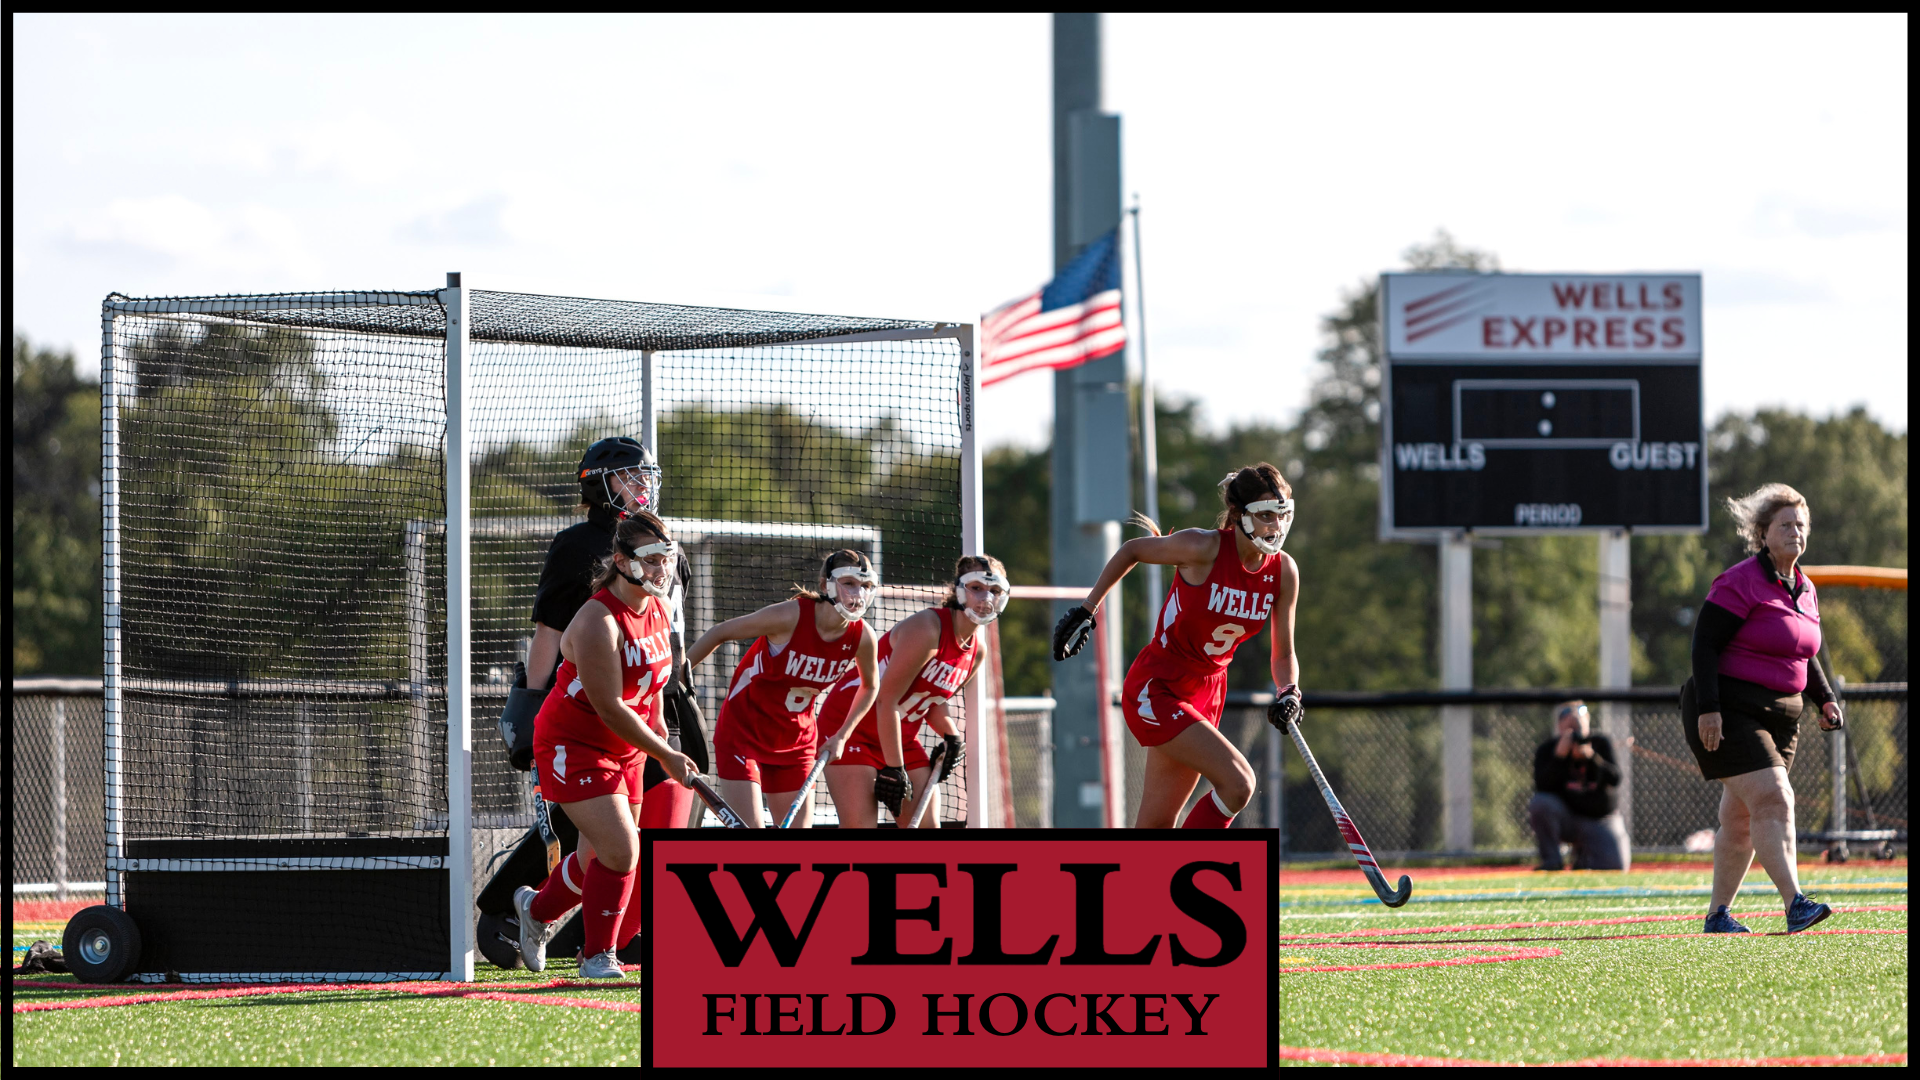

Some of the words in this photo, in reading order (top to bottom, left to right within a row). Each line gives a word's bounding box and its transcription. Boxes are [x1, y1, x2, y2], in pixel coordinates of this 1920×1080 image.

[1552, 283, 1684, 311] WELLS
[1482, 317, 1686, 348] EXPRESS
[964, 404, 972, 432] sports
[1396, 442, 1486, 470] WELLS
[1609, 442, 1699, 470] GUEST
[1515, 503, 1582, 526] PERIOD
[1207, 582, 1274, 620] WELLS
[1203, 622, 1246, 656] 9
[717, 807, 741, 829] STX
